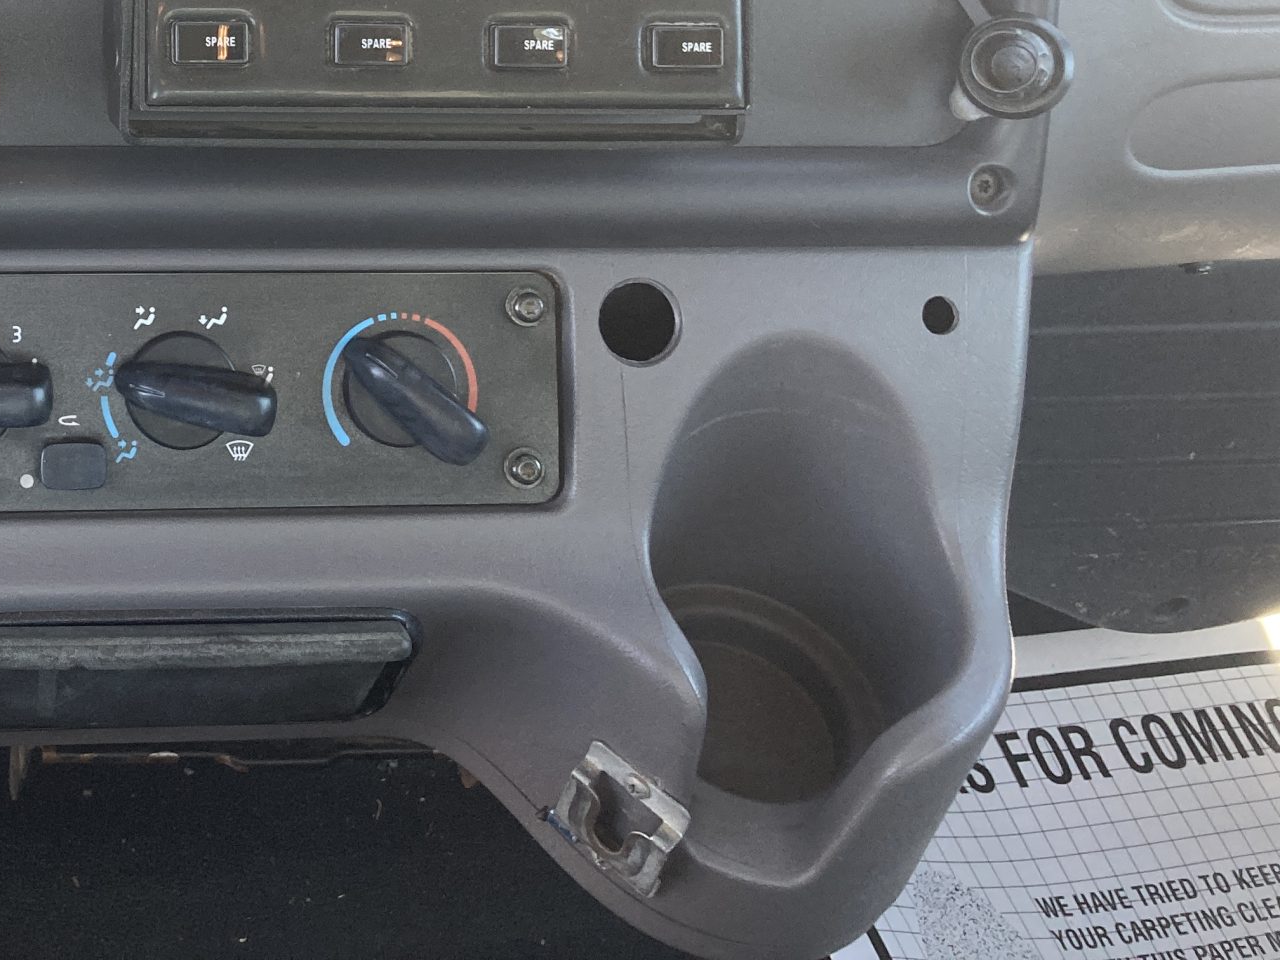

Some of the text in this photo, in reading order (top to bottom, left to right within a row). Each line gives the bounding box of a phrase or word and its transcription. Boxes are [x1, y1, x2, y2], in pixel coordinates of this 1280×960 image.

[205, 37, 236, 47] SPARE
[361, 38, 392, 49] SPARE
[524, 40, 554, 51] SPARE
[682, 42, 712, 53] SPARE
[12, 326, 22, 343] 3
[994, 724, 1113, 790] FOR
[1035, 894, 1075, 919] WE
[1072, 888, 1133, 916] HAVE
[1131, 878, 1199, 907] TRIED
[1198, 872, 1231, 896] TO
[1050, 925, 1115, 952] YOUR
[1115, 906, 1237, 946] CARPETING
